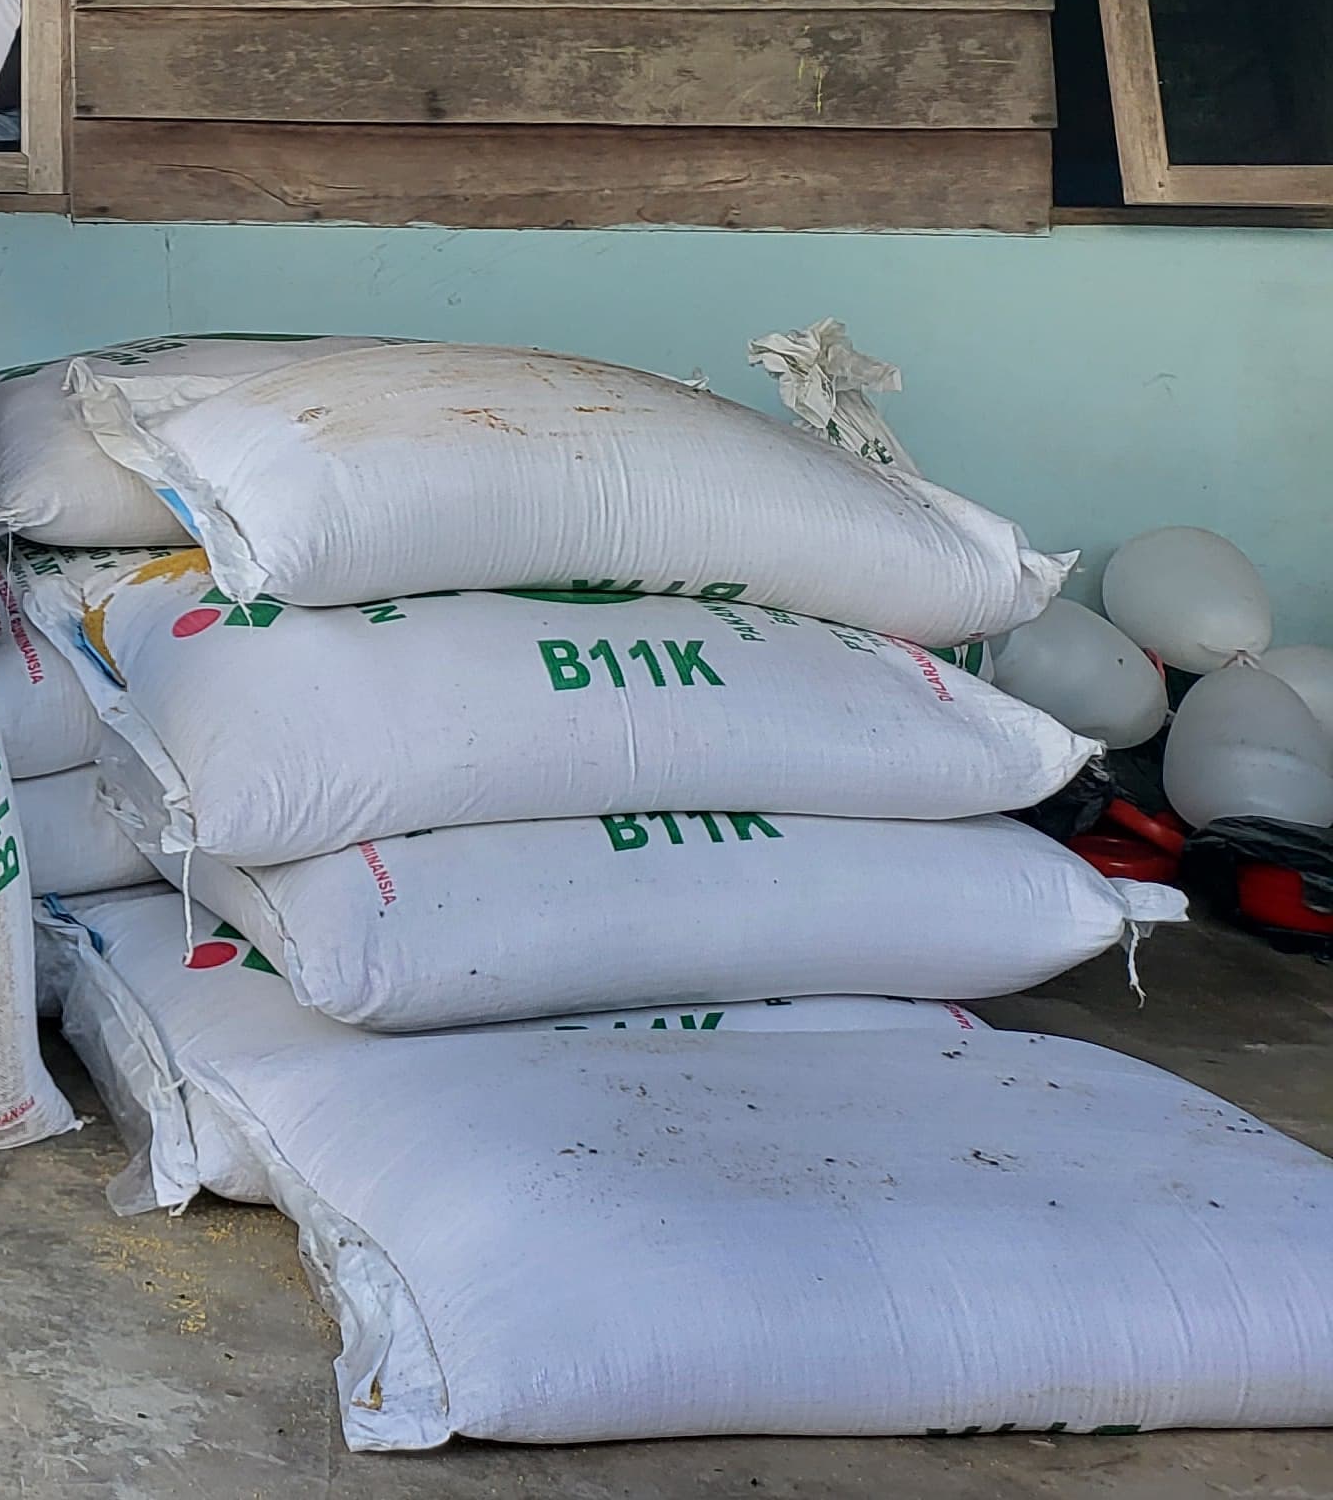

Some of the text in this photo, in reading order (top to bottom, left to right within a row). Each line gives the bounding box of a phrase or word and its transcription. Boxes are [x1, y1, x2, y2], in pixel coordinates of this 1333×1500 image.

[10, 616, 45, 685] RUMINANSIA
[537, 638, 727, 692] B11K
[598, 811, 784, 852] B11K
[357, 840, 398, 907] MINANSIA
